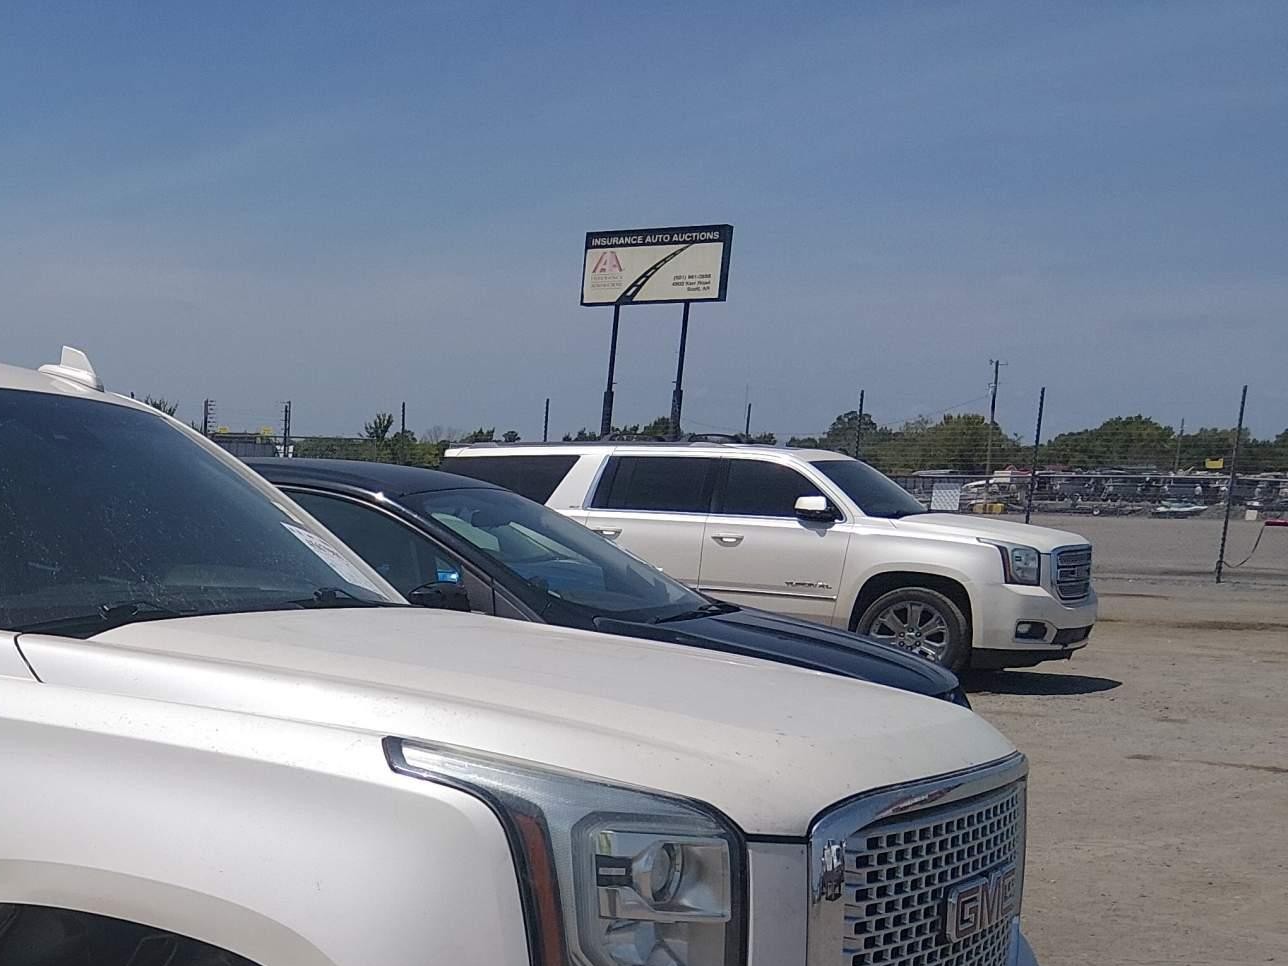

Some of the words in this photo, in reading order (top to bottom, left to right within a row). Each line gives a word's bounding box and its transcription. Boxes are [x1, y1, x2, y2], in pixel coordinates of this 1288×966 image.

[591, 235, 643, 246] INSURANCE
[645, 234, 671, 243] AUTO
[672, 231, 720, 242] AUCTIONS
[954, 867, 1016, 939] GMC
